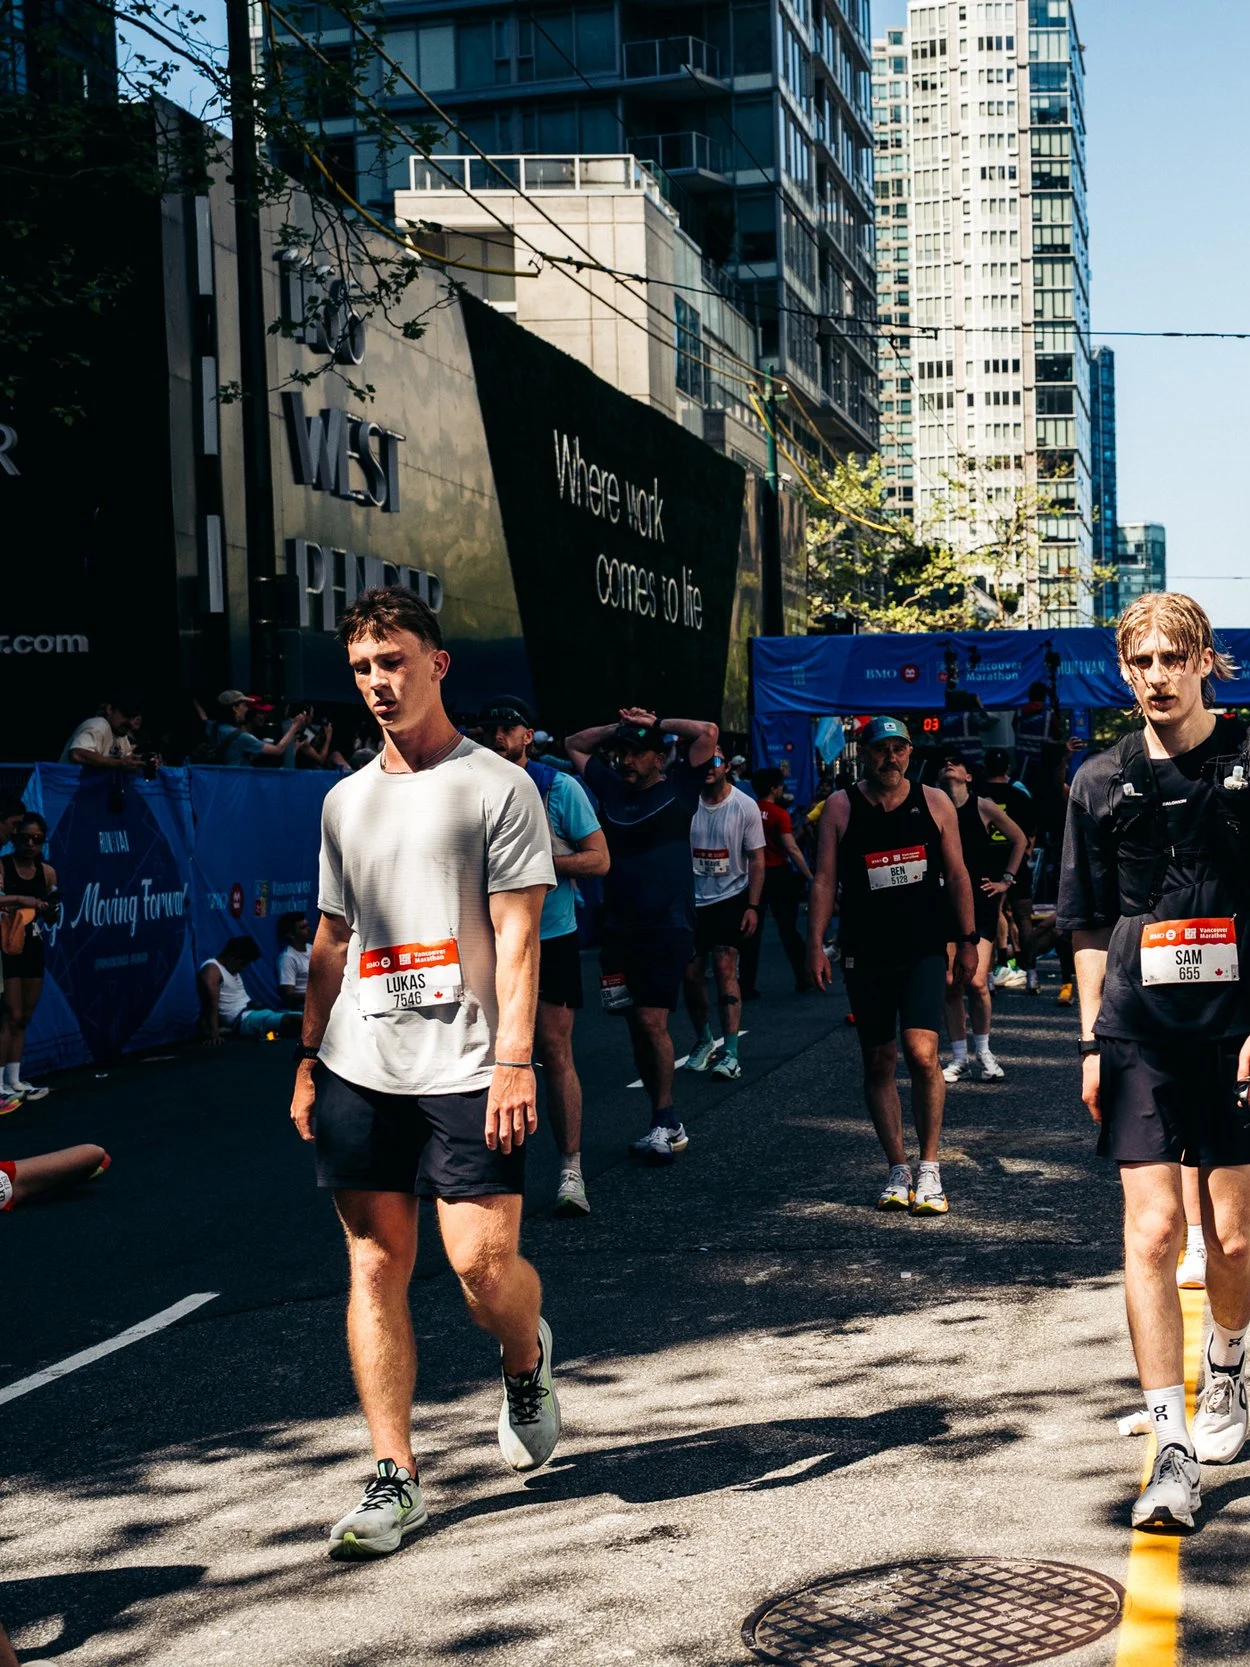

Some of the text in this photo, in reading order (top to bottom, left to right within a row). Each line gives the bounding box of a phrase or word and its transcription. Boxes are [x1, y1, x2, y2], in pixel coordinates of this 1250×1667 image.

[281, 391, 406, 512] WEST
[553, 430, 665, 542] Where work
[596, 554, 702, 630] comes to life
[865, 669, 897, 679] BMO
[966, 670, 1019, 681] Marathon
[922, 716, 941, 732] 03
[890, 866, 906, 876] BEN
[891, 875, 908, 884] 5128
[71, 882, 138, 939] Moving
[413, 949, 446, 958] Vancouver
[414, 954, 444, 963] Marathon
[1176, 949, 1202, 966] SAM
[1179, 966, 1200, 980] 655
[386, 973, 426, 994] LUKAS
[393, 991, 423, 1009] 7546
